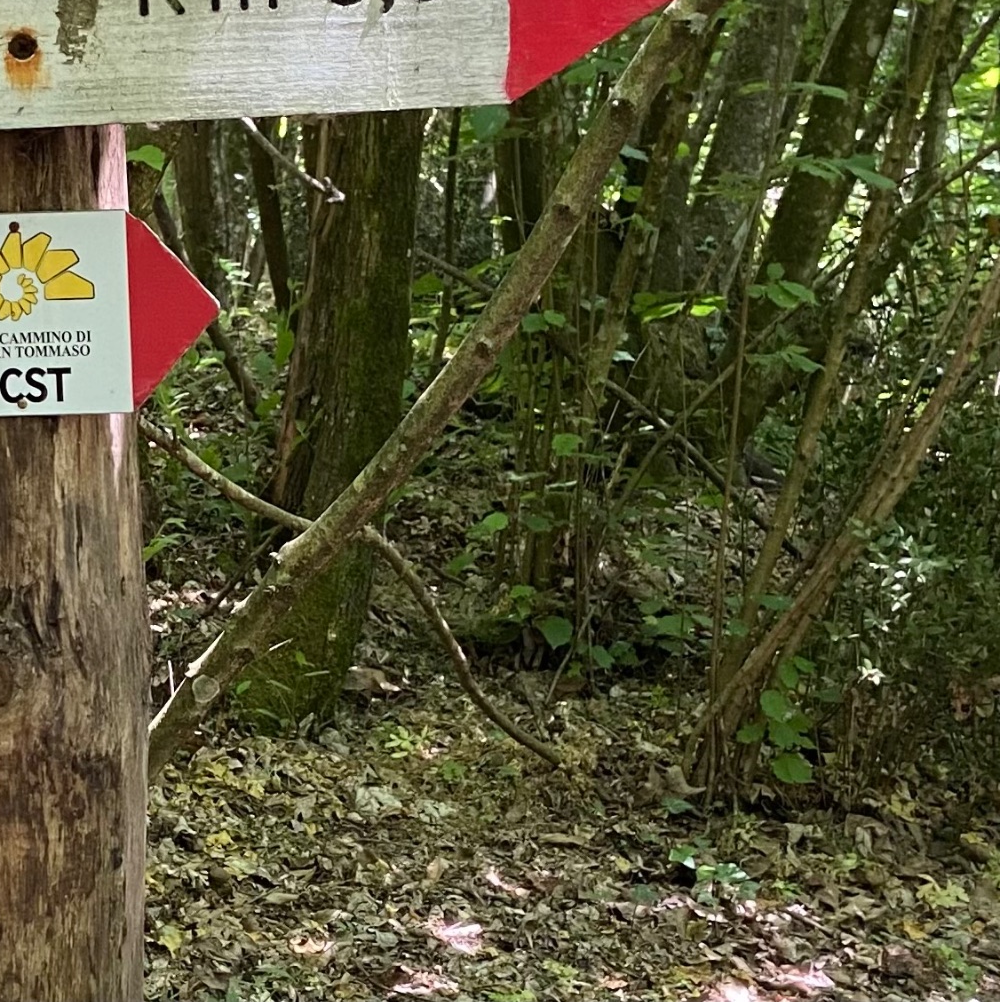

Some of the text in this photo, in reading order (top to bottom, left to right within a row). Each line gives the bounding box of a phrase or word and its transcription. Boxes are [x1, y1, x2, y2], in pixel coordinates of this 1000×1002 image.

[75, 330, 92, 343] DI
[14, 344, 91, 359] TOMMASO
[0, 367, 72, 403] CST
